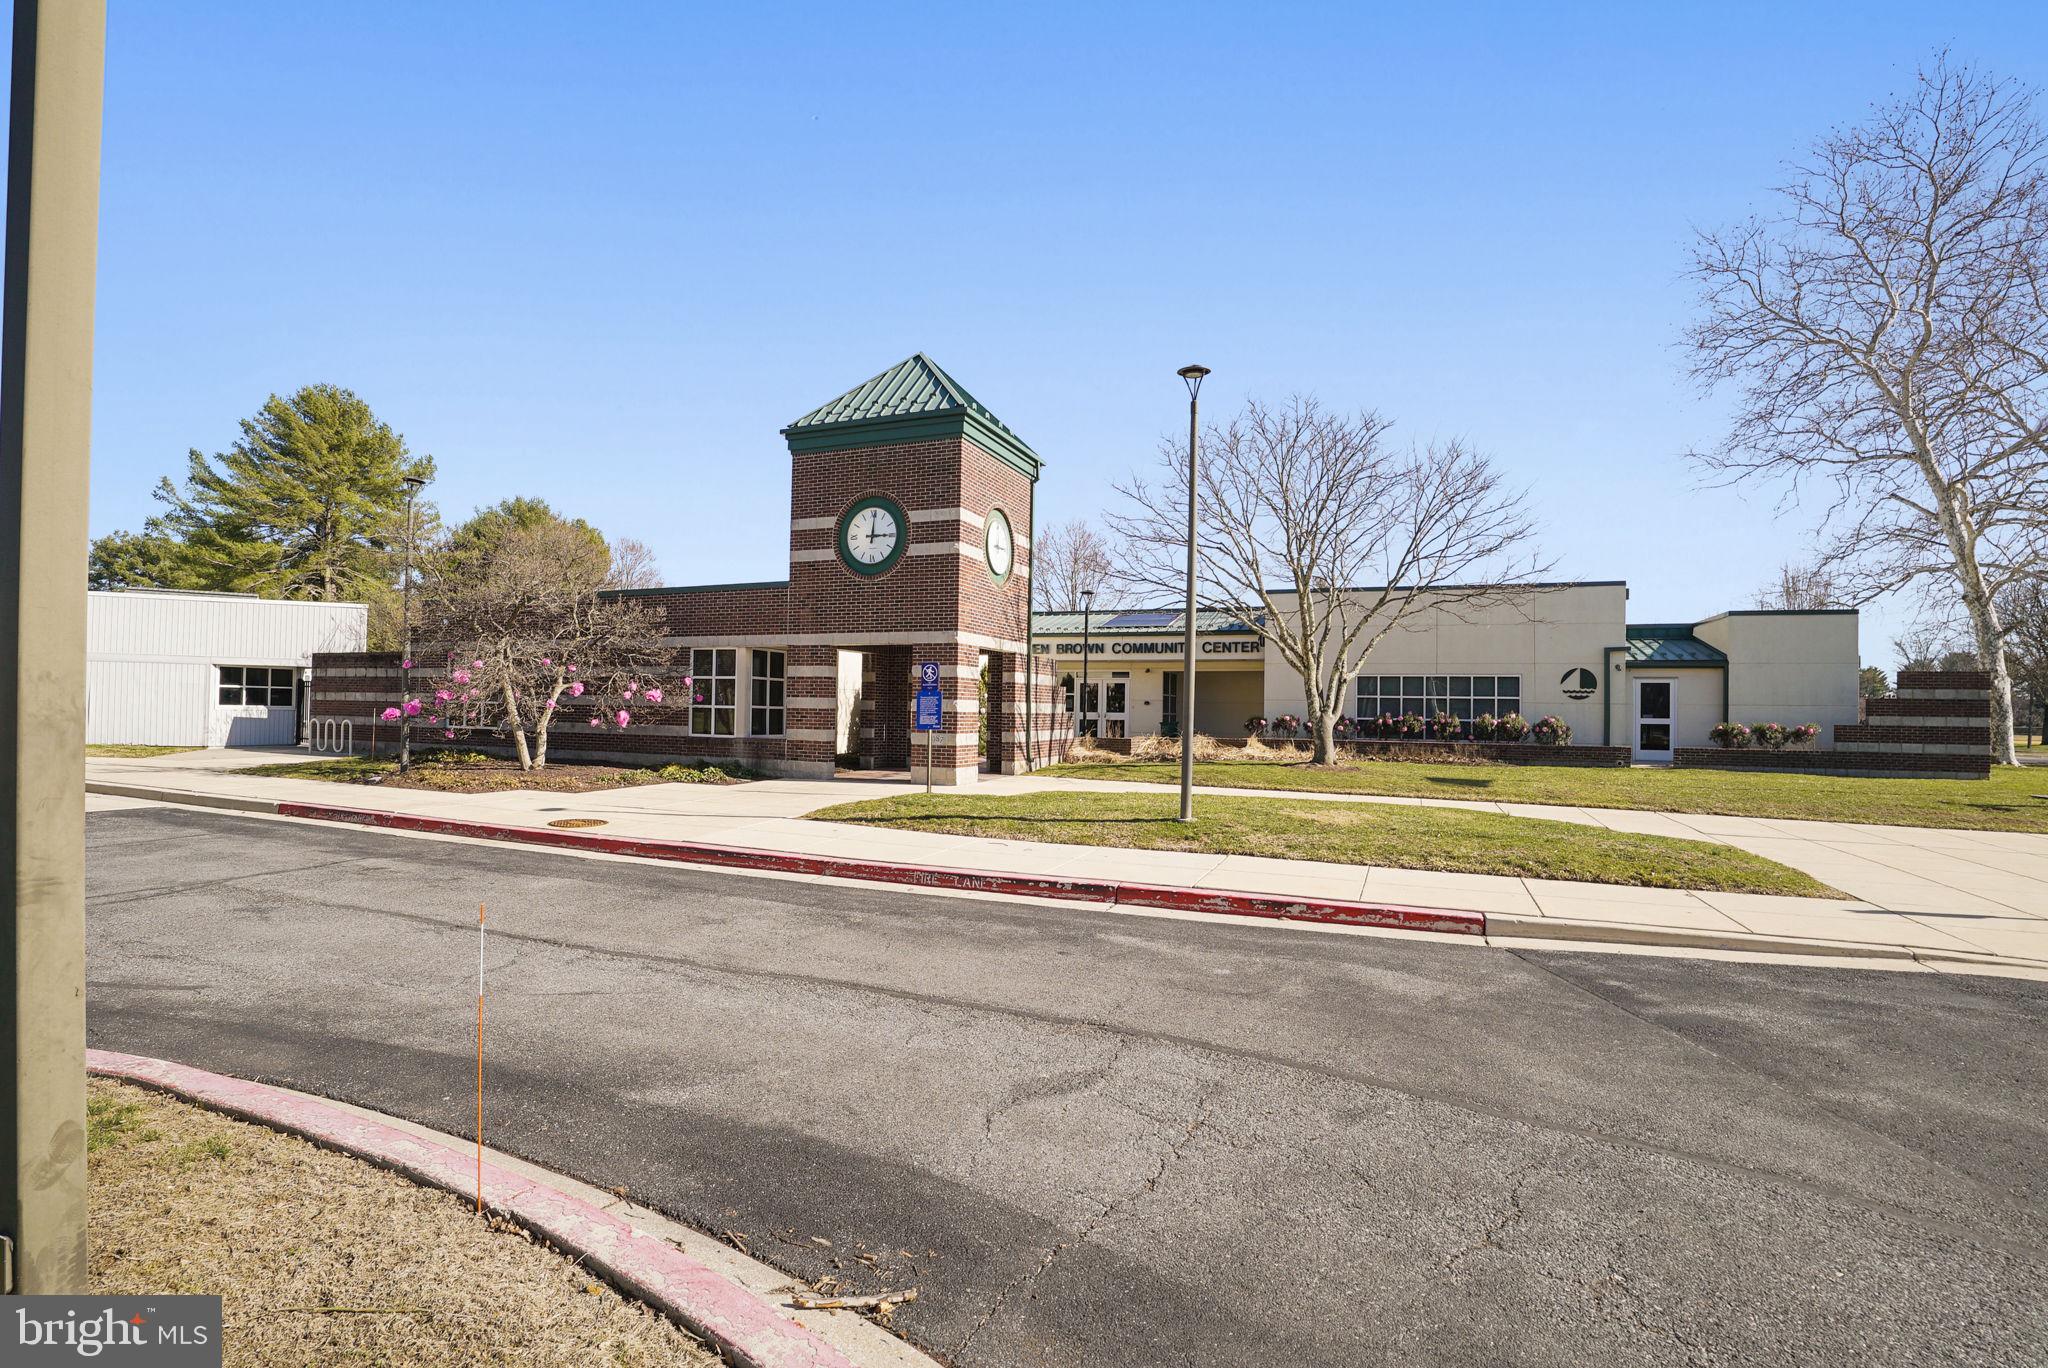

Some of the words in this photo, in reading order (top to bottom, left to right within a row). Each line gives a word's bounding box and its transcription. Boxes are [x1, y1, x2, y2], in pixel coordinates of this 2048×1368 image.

[1032, 643, 1050, 655] EN
[1056, 642, 1105, 655] BROWN
[1111, 642, 1186, 655] COMMUNIT
[1202, 641, 1261, 654] CENTER
